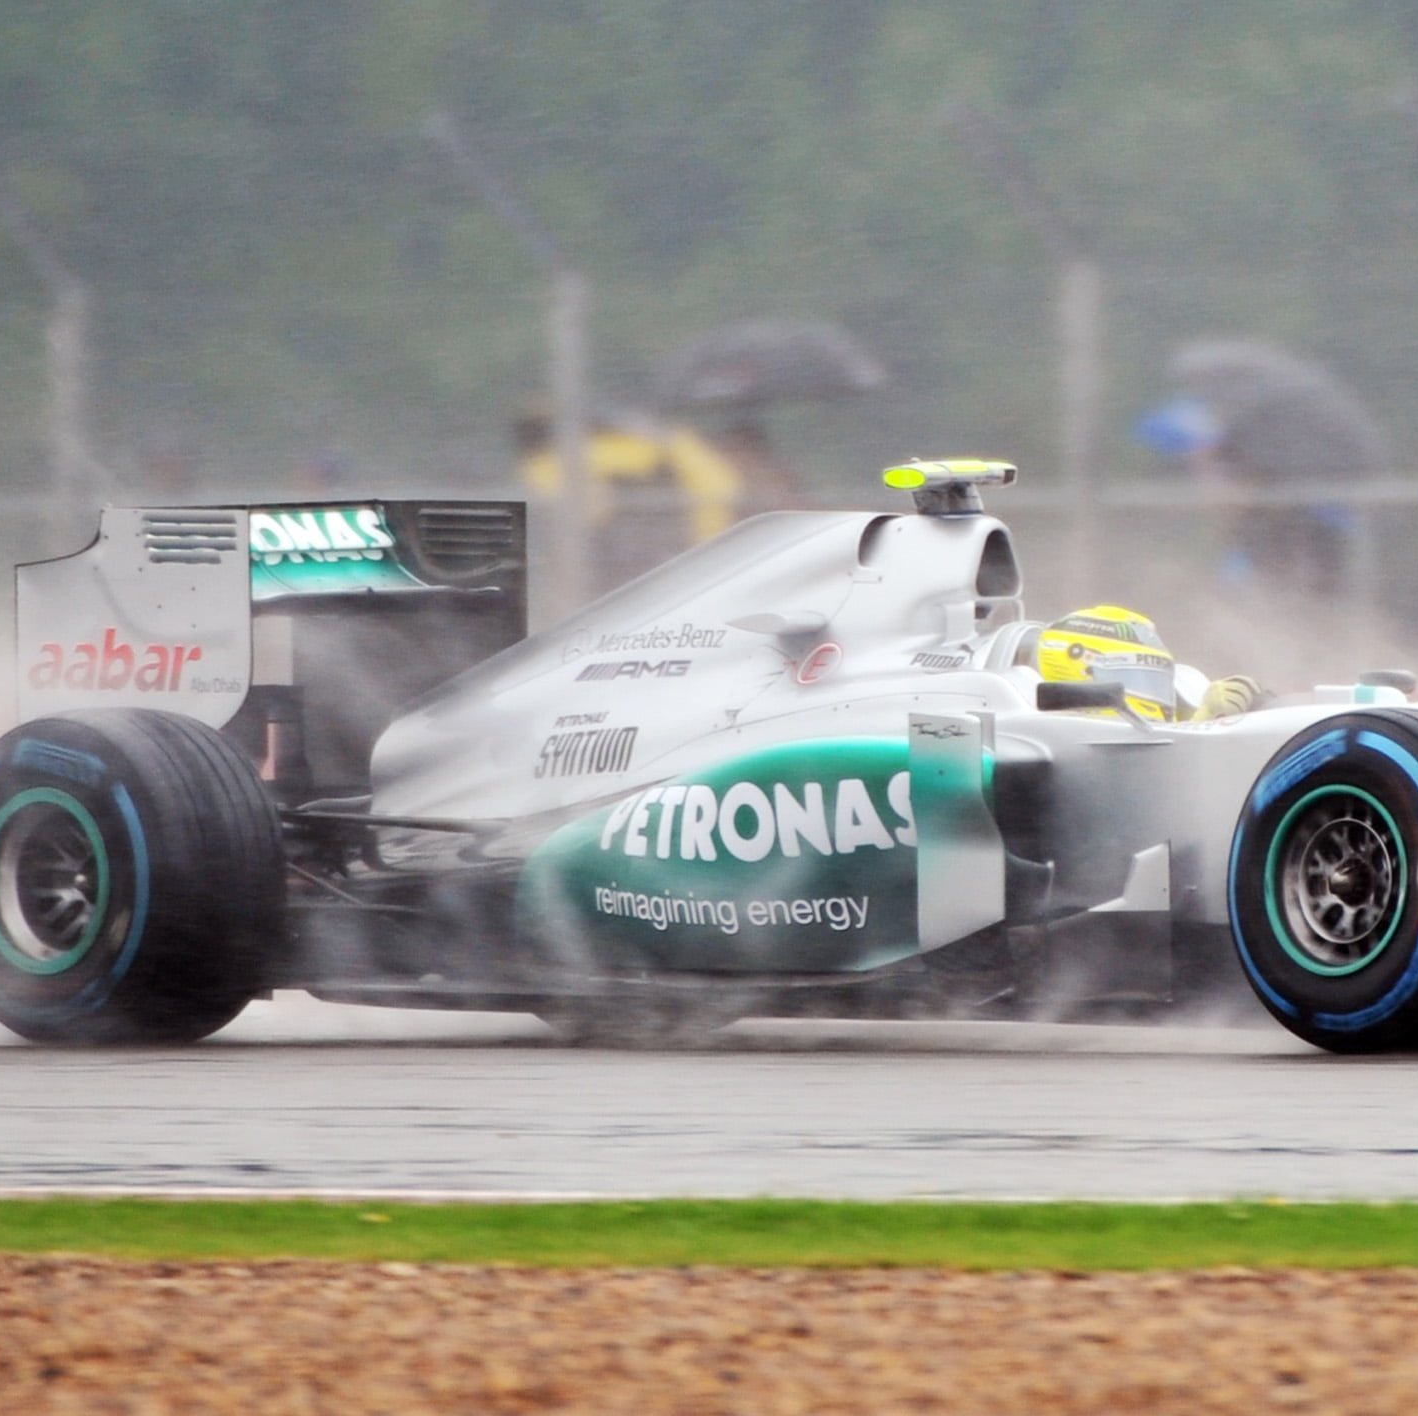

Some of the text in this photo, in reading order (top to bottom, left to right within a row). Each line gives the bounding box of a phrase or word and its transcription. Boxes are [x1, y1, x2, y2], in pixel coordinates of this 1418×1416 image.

[250, 509, 393, 565] ONAS
[28, 628, 203, 693] aabar
[612, 660, 693, 680] AMG
[534, 726, 639, 779] SYNTIUM
[600, 771, 918, 862] PETRONAS
[595, 881, 869, 934] reimagining energy
